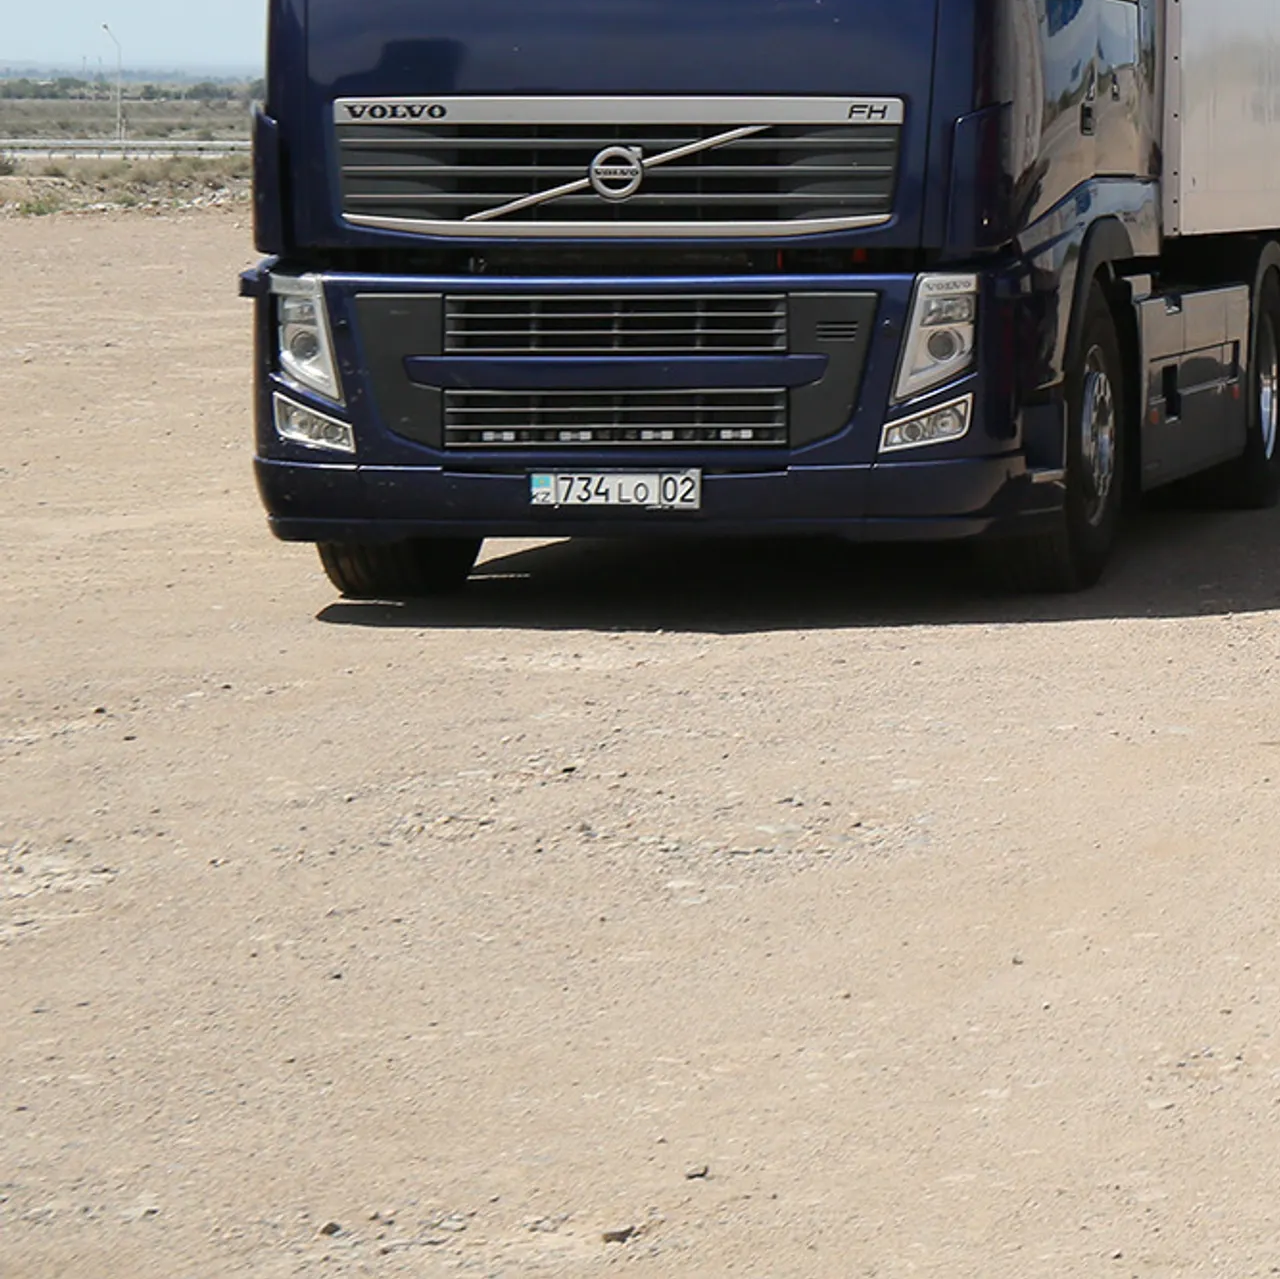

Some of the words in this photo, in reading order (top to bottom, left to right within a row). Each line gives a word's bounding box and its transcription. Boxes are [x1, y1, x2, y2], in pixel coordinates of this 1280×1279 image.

[344, 104, 447, 119] VOLVO
[848, 104, 889, 120] FH
[924, 280, 972, 292] VOLVO
[559, 476, 610, 503] 734
[662, 476, 696, 503] 02
